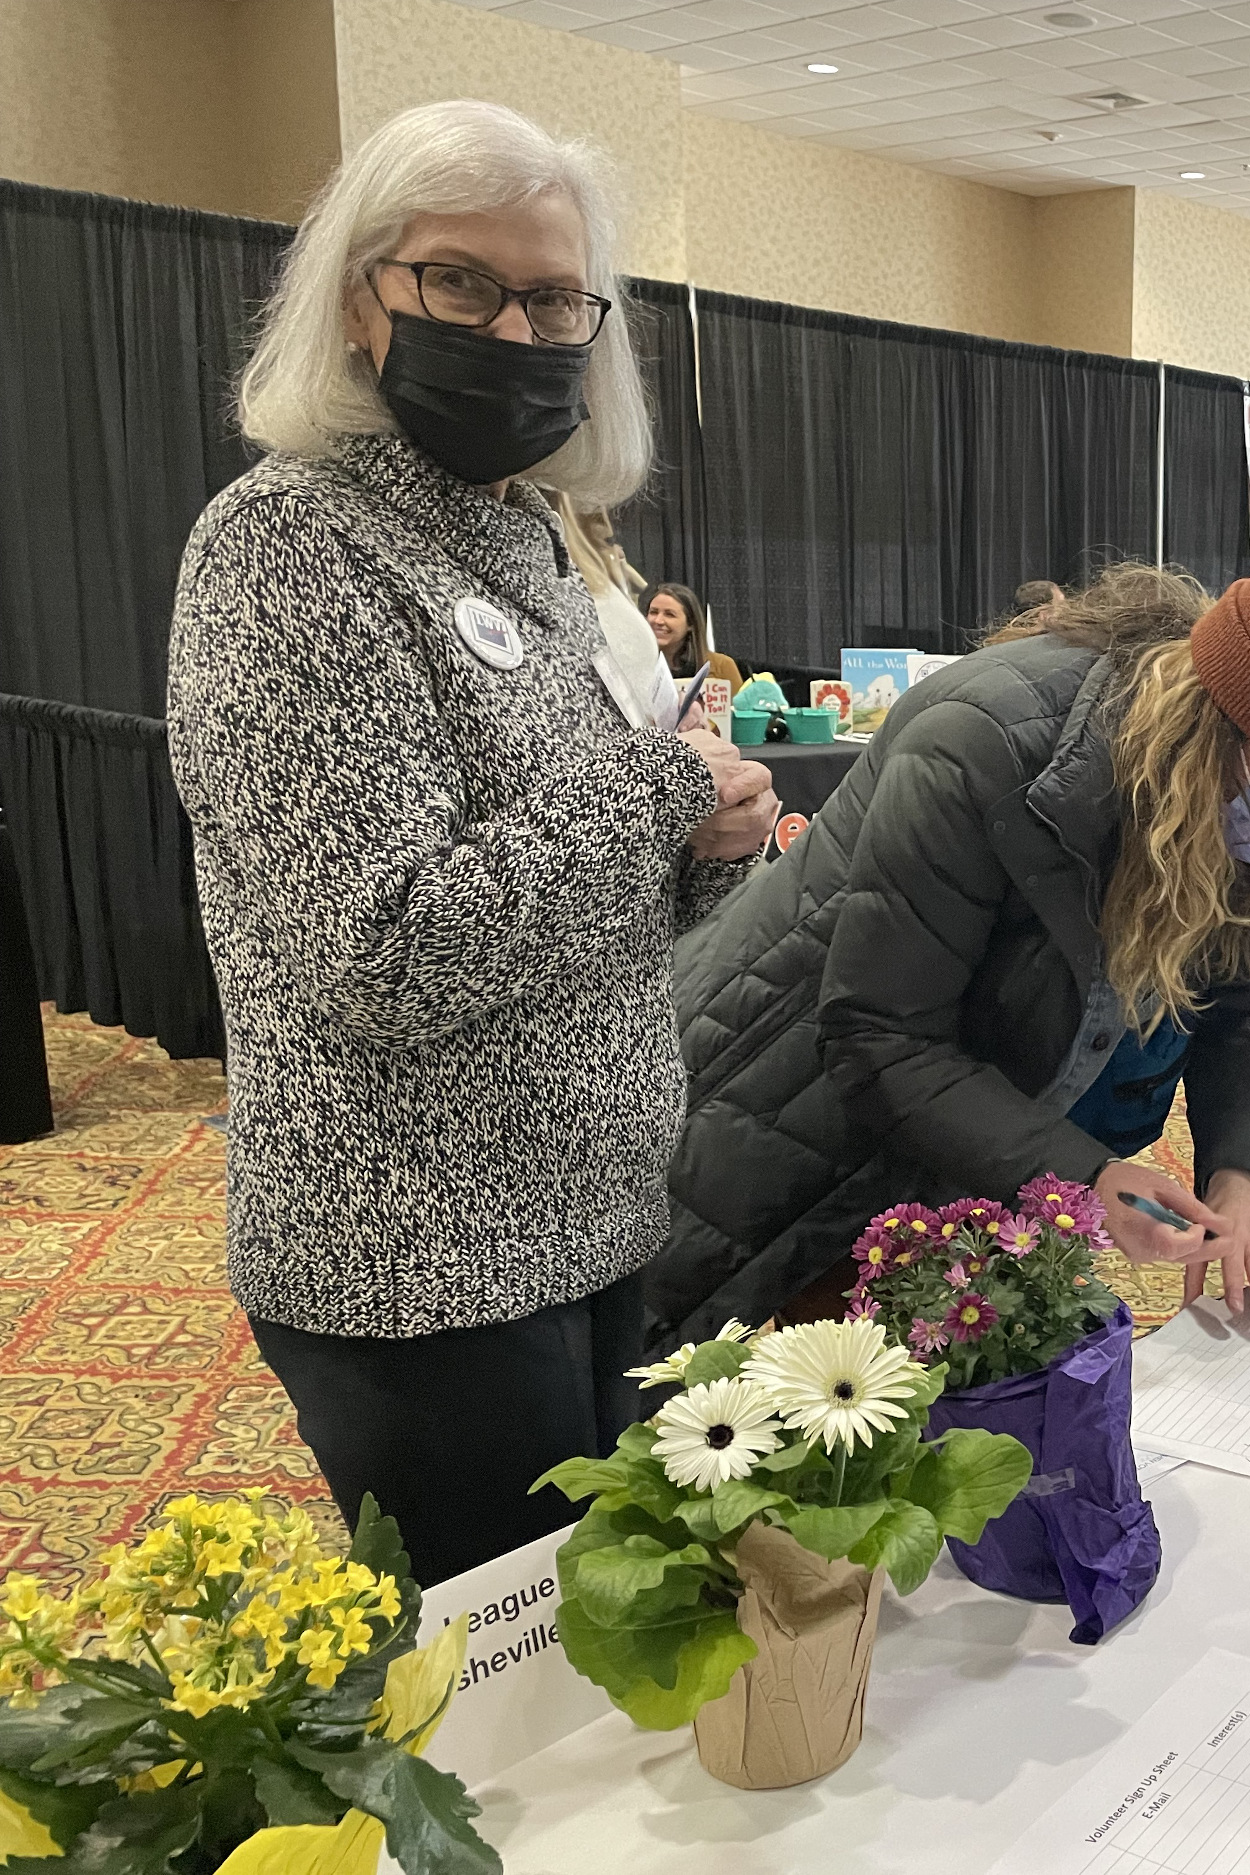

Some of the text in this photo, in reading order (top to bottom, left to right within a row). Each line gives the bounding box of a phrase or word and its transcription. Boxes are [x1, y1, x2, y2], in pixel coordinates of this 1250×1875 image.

[884, 658, 908, 669] Wor
[706, 693, 718, 703] Do
[712, 684, 727, 693] Can
[707, 703, 725, 713] Too!
[443, 1577, 555, 1634] eague
[457, 1623, 560, 1692] sheville
[1207, 1710, 1248, 1748] Interest(s)
[1084, 1751, 1179, 1845] Volunteer Sign Up Sheet
[1141, 1791, 1172, 1820] E-Mail
